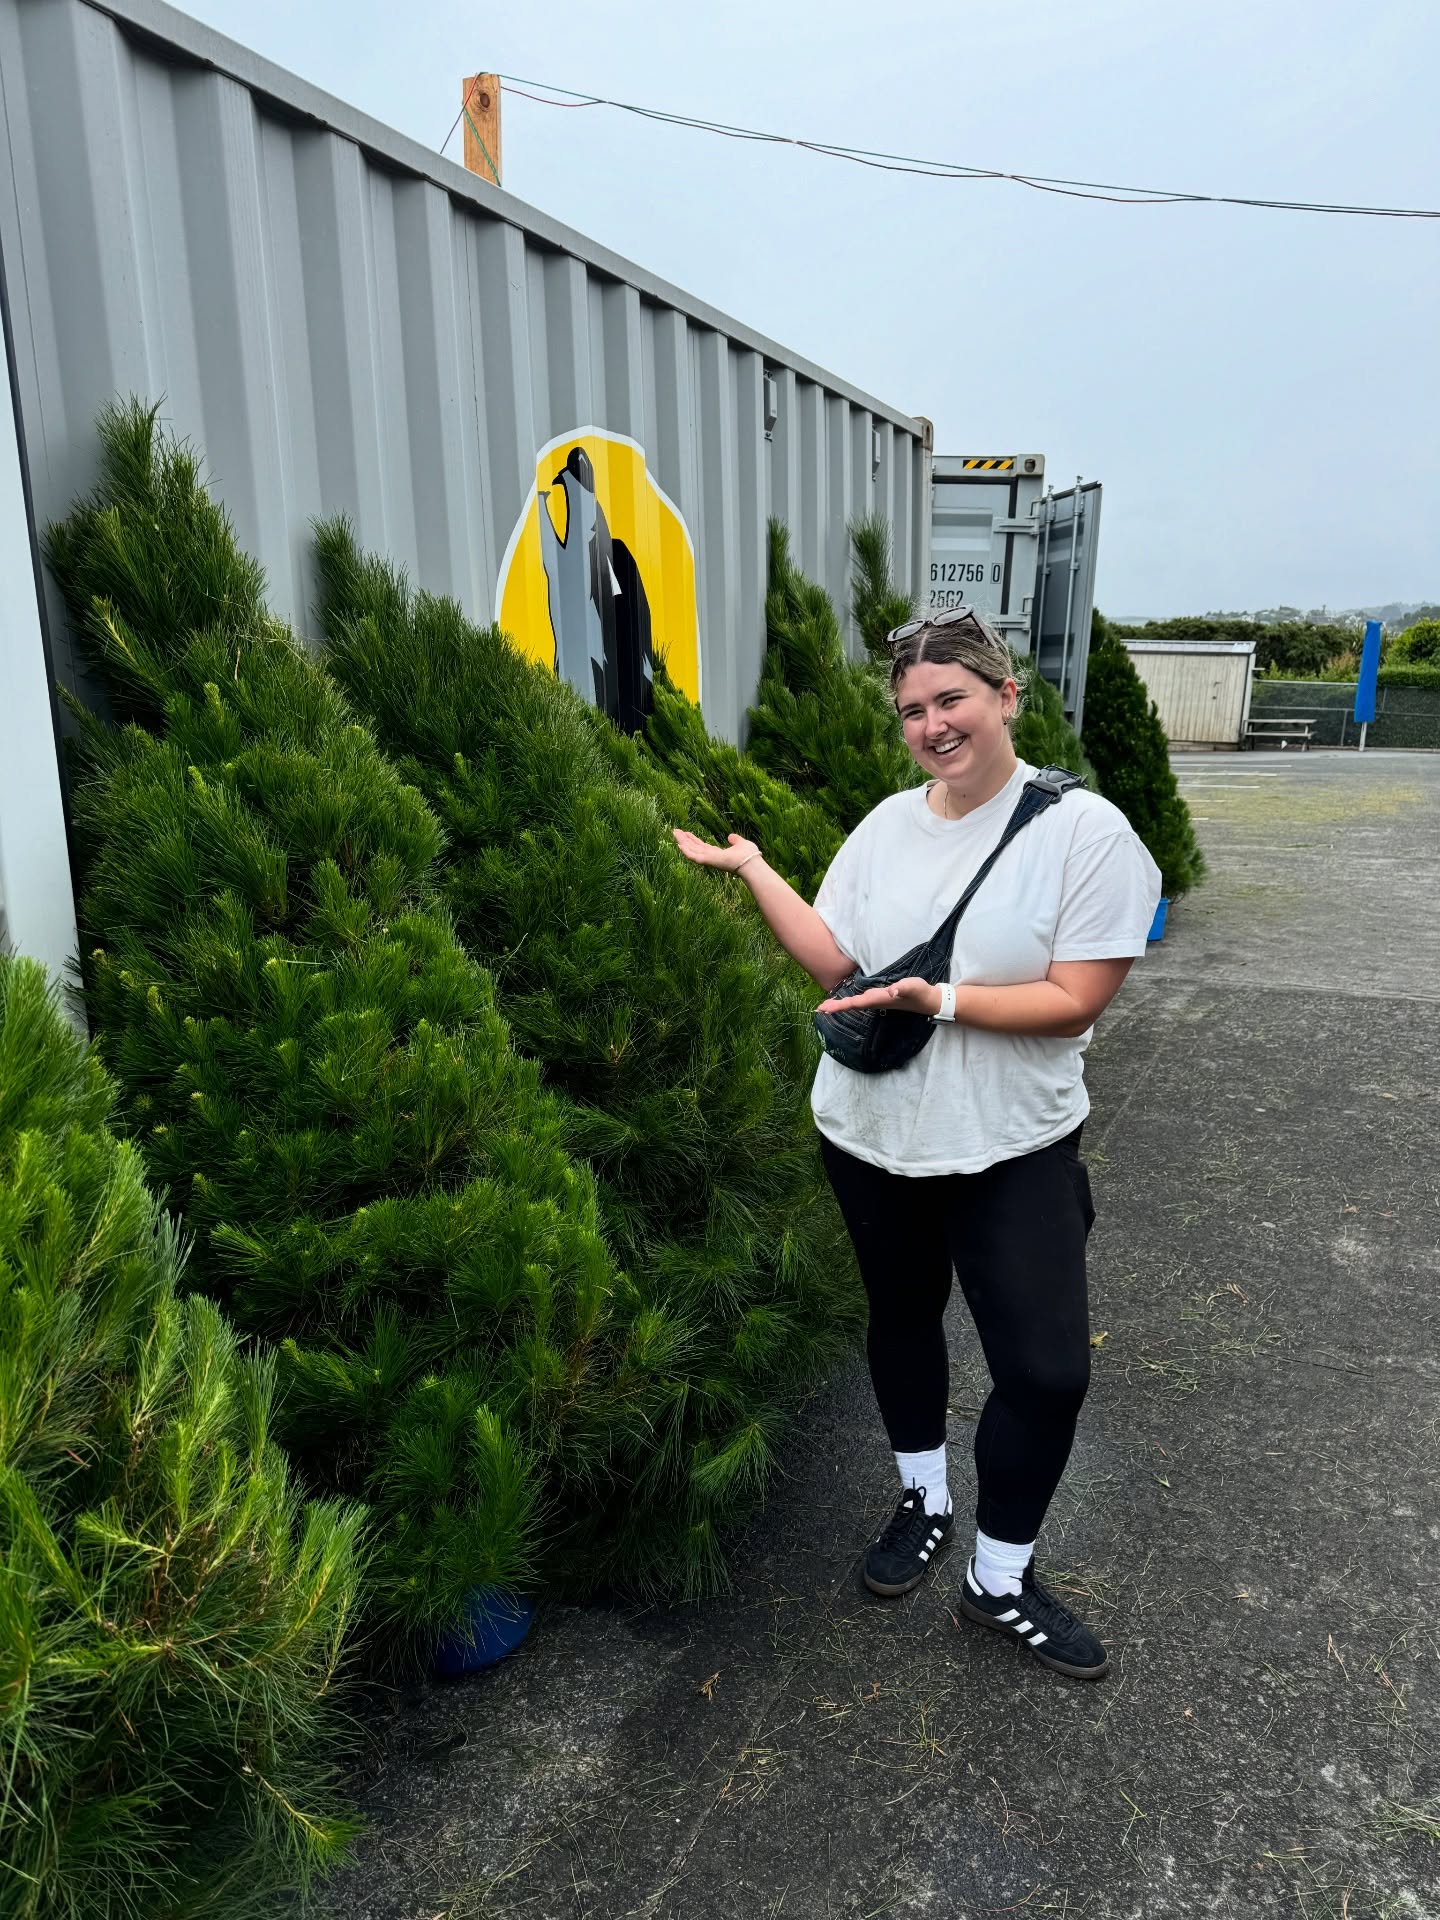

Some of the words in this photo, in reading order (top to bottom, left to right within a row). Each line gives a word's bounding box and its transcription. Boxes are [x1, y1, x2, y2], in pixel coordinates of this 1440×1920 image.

[930, 563, 984, 582] 612756
[992, 564, 1001, 582] 0
[930, 590, 963, 608] 25G2
